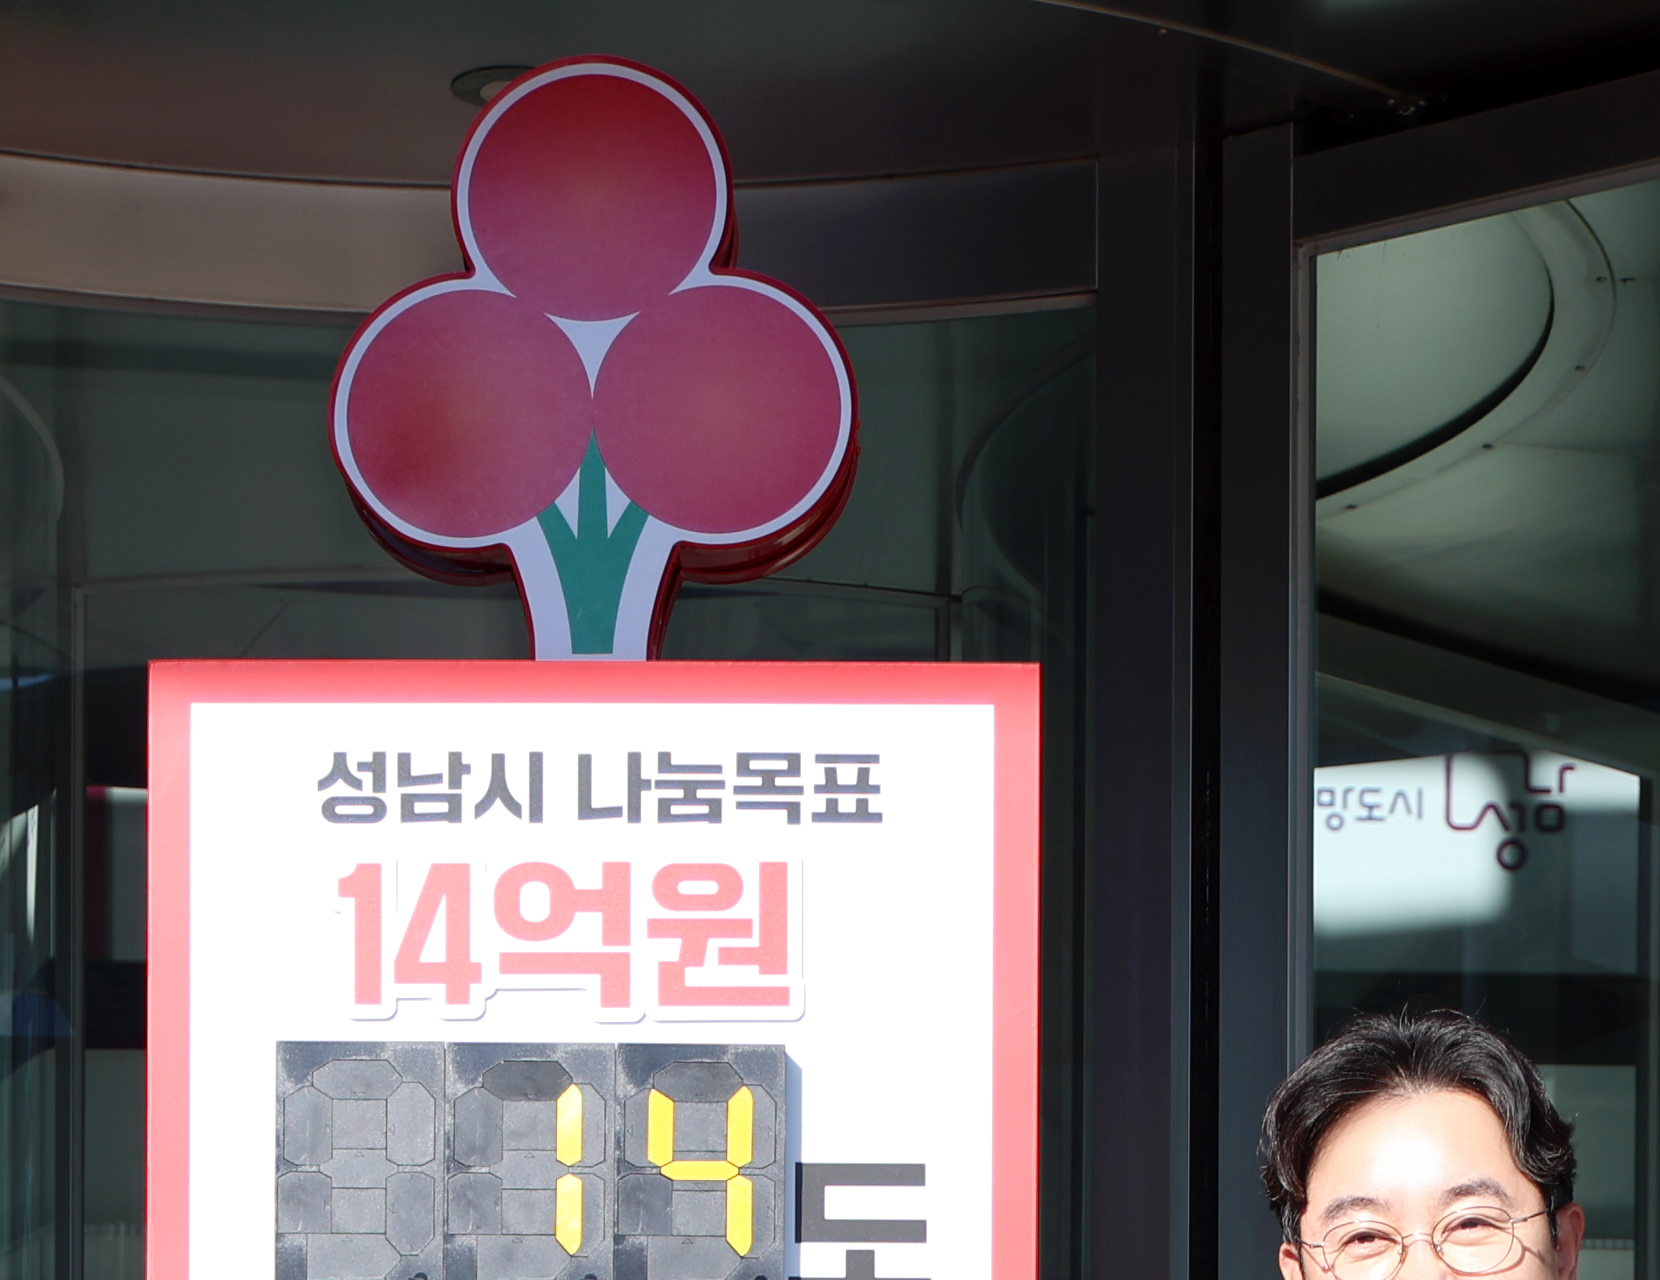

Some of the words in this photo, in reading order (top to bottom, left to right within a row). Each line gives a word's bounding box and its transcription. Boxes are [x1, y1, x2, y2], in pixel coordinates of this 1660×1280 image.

[317, 751, 543, 824] 성남시
[577, 751, 883, 825] 나눔목표
[339, 861, 790, 1008] 14억원
[554, 1085, 755, 1257] 14
